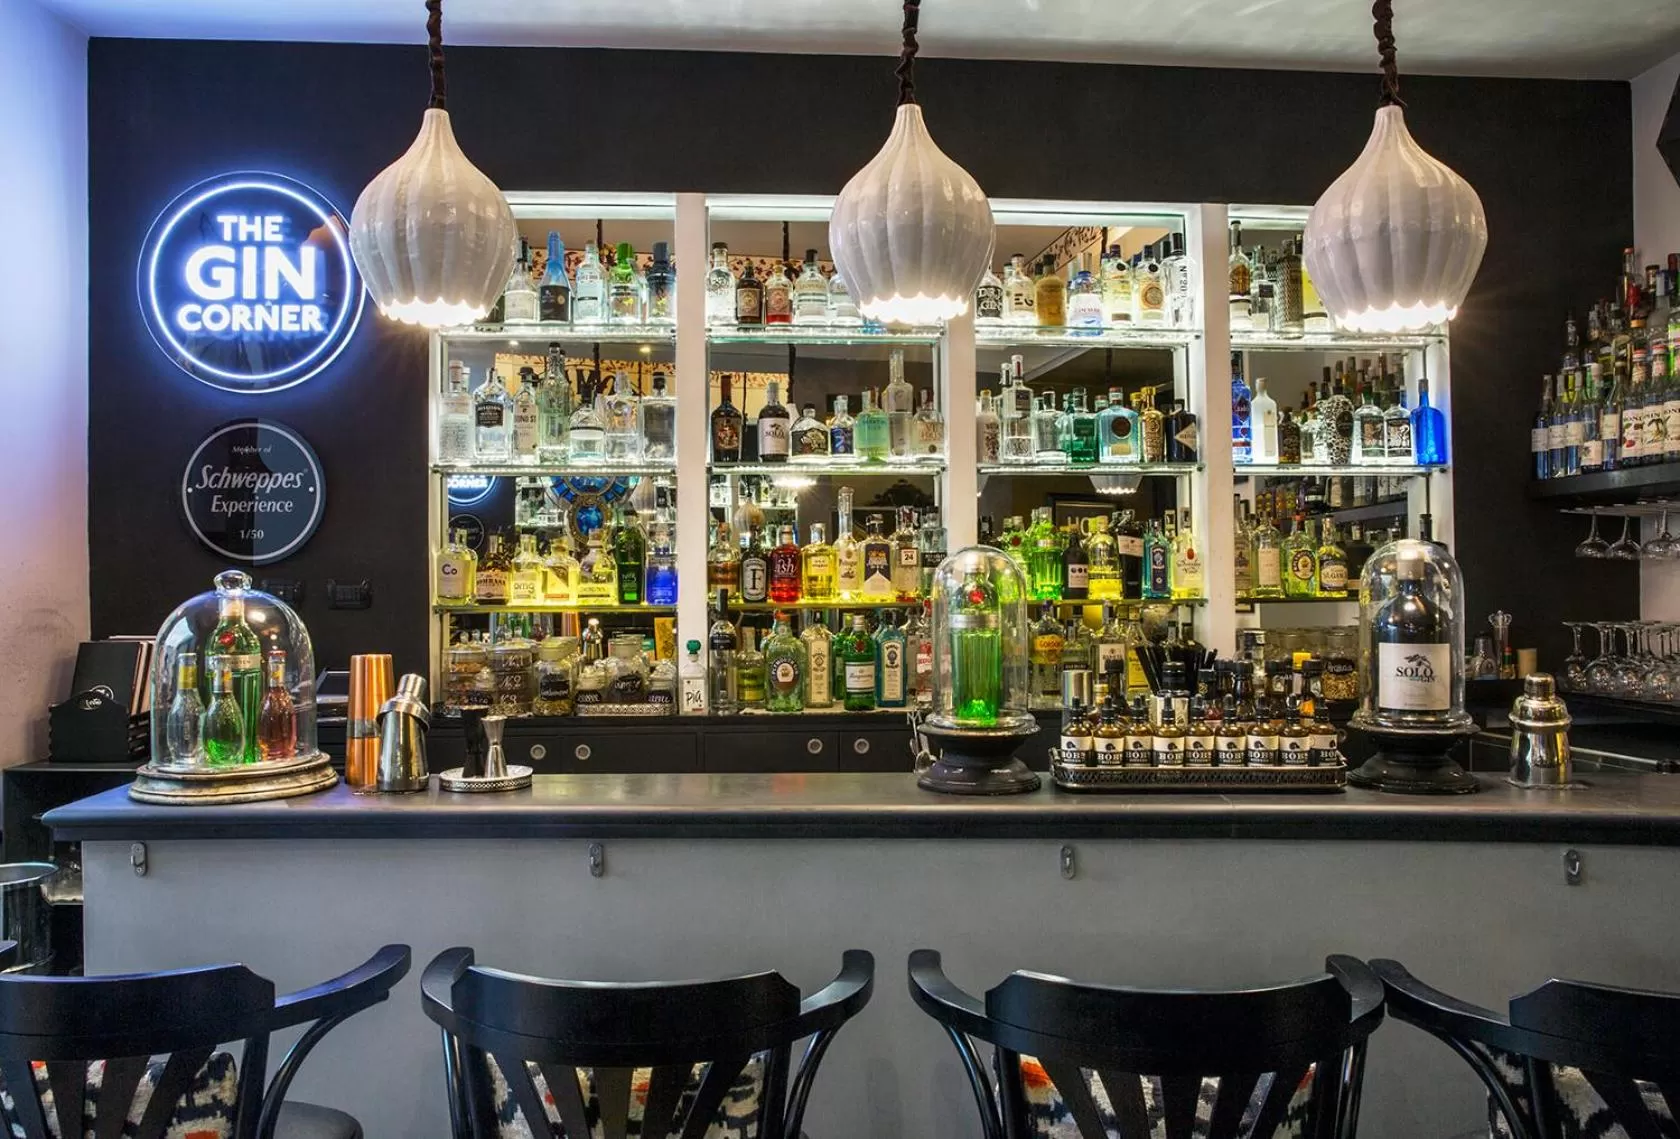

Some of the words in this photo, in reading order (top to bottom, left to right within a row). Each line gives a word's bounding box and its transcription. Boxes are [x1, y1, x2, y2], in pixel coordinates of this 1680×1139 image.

[216, 215, 283, 242] THE
[185, 245, 316, 300] GIN
[177, 303, 323, 332] CORNER
[195, 464, 304, 494] Schweppes
[210, 494, 294, 518] Experience
[240, 529, 264, 540] 1/50
[1395, 666, 1434, 678] SOLO
